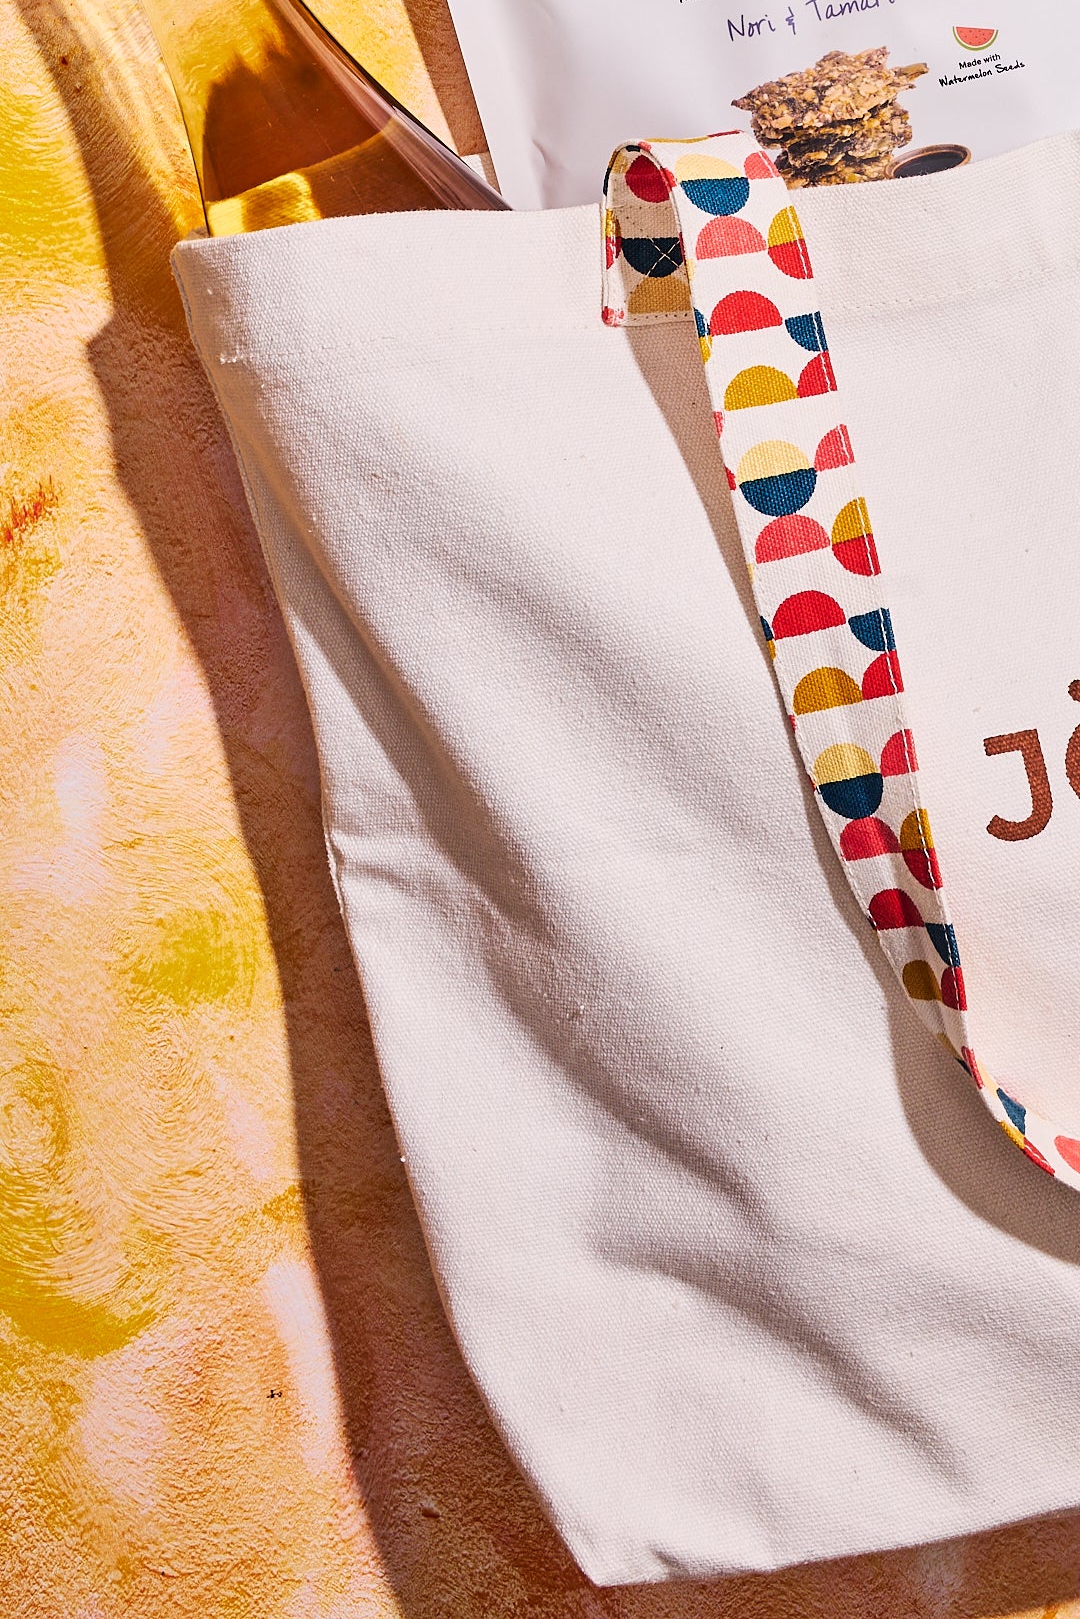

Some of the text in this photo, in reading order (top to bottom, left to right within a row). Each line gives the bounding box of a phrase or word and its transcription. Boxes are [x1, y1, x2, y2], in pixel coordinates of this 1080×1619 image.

[727, 15, 776, 42] Nori
[938, 60, 1026, 87] Watermelon Seeds
[959, 53, 1001, 69] Made with
